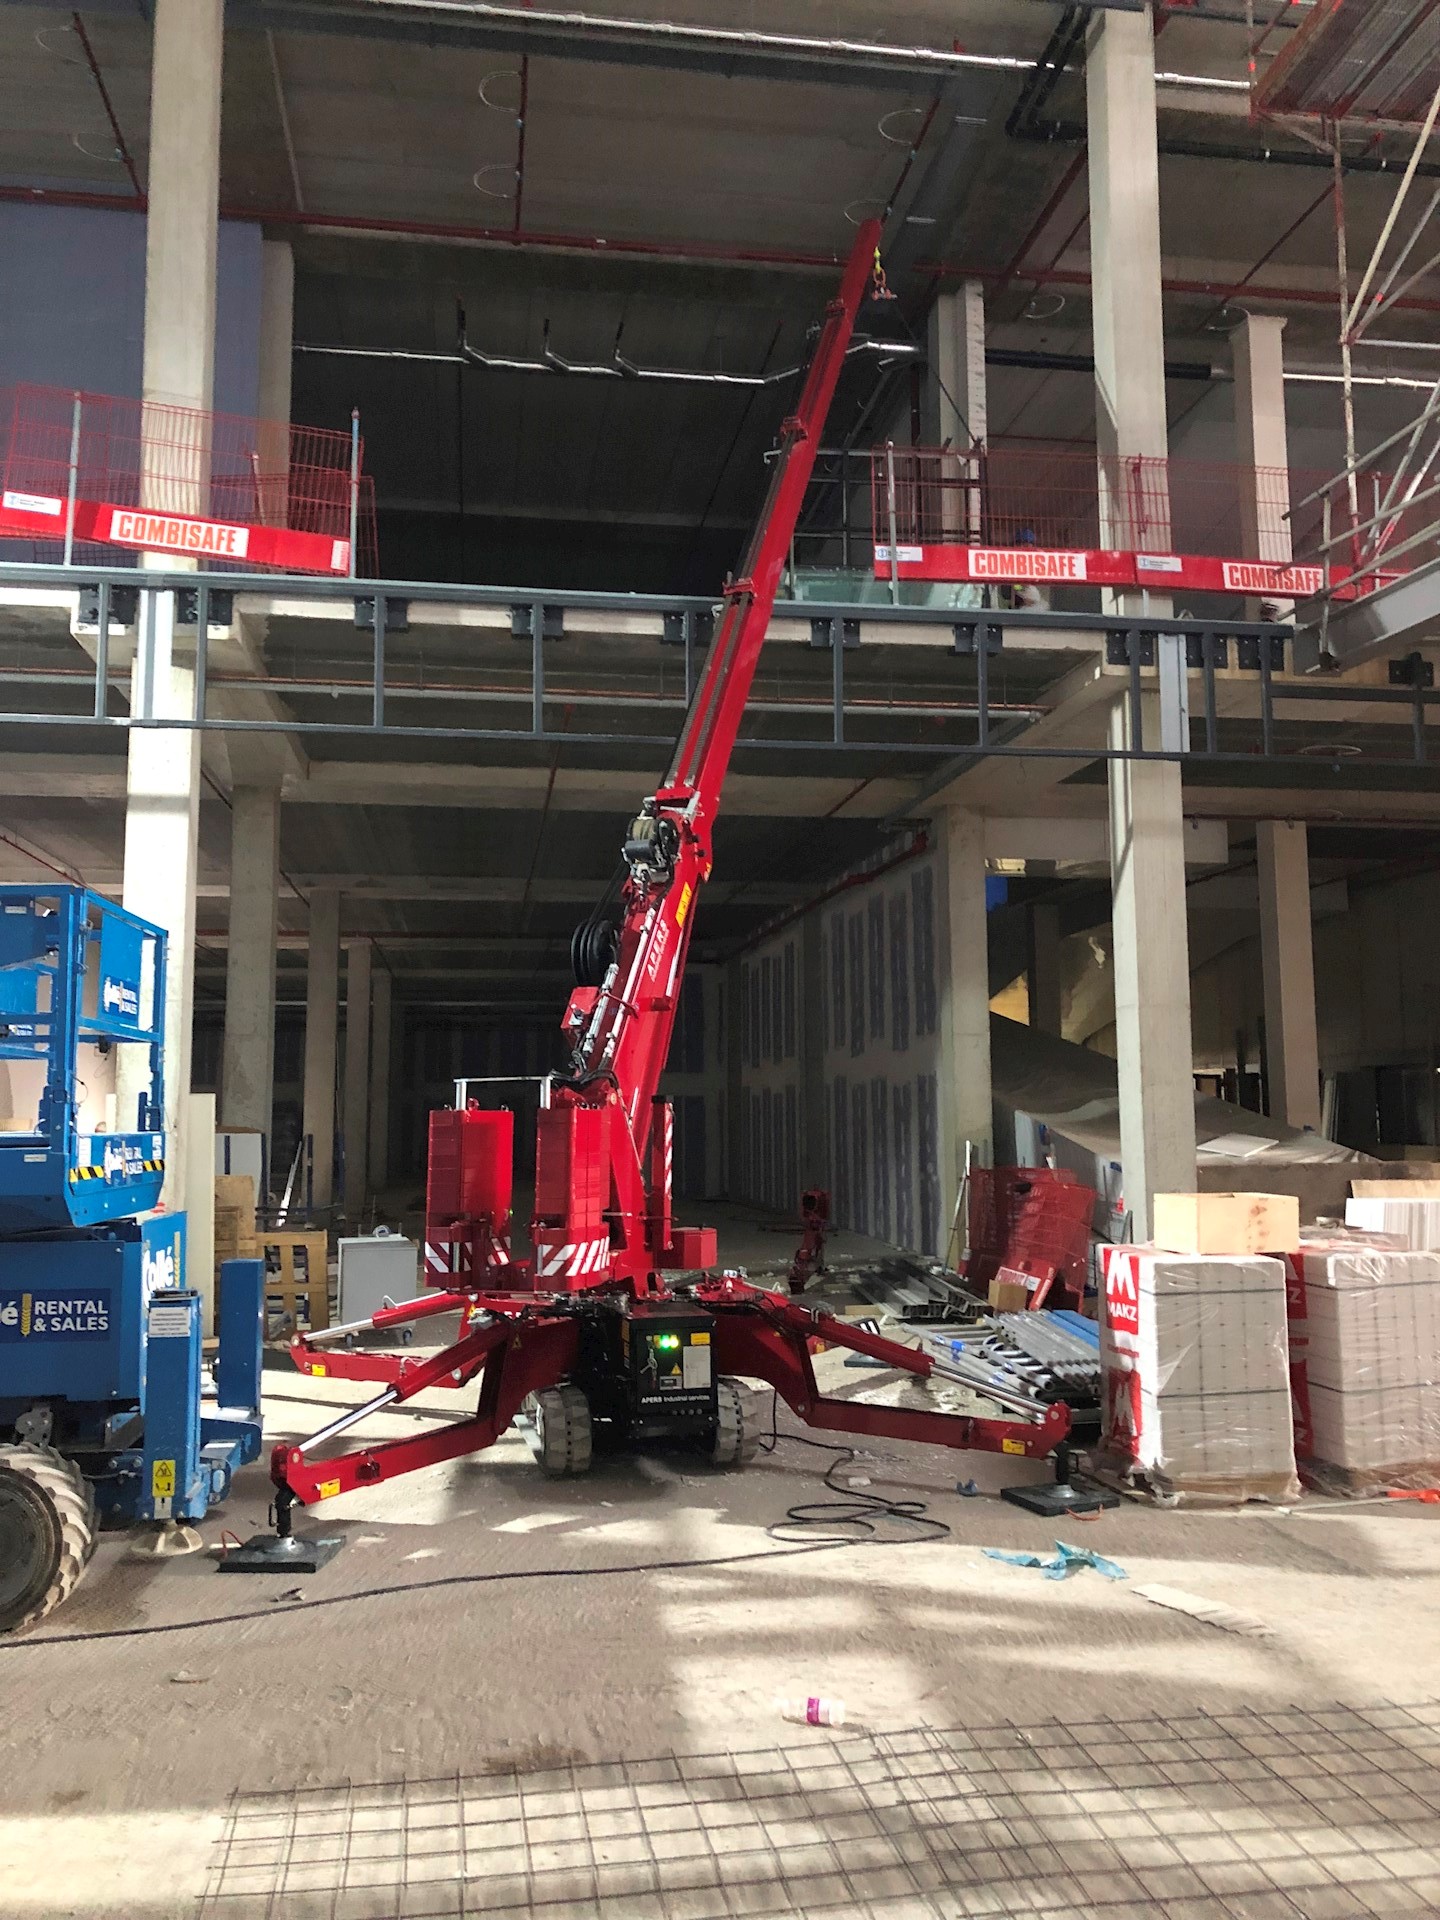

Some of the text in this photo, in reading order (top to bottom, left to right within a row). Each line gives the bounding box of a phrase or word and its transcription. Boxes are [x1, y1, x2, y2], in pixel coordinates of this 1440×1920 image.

[118, 514, 237, 553] COMBISAFE
[974, 552, 1077, 577] COMBISAFE
[34, 1300, 109, 1315] RENTAL
[33, 1316, 109, 1332] & SALES
